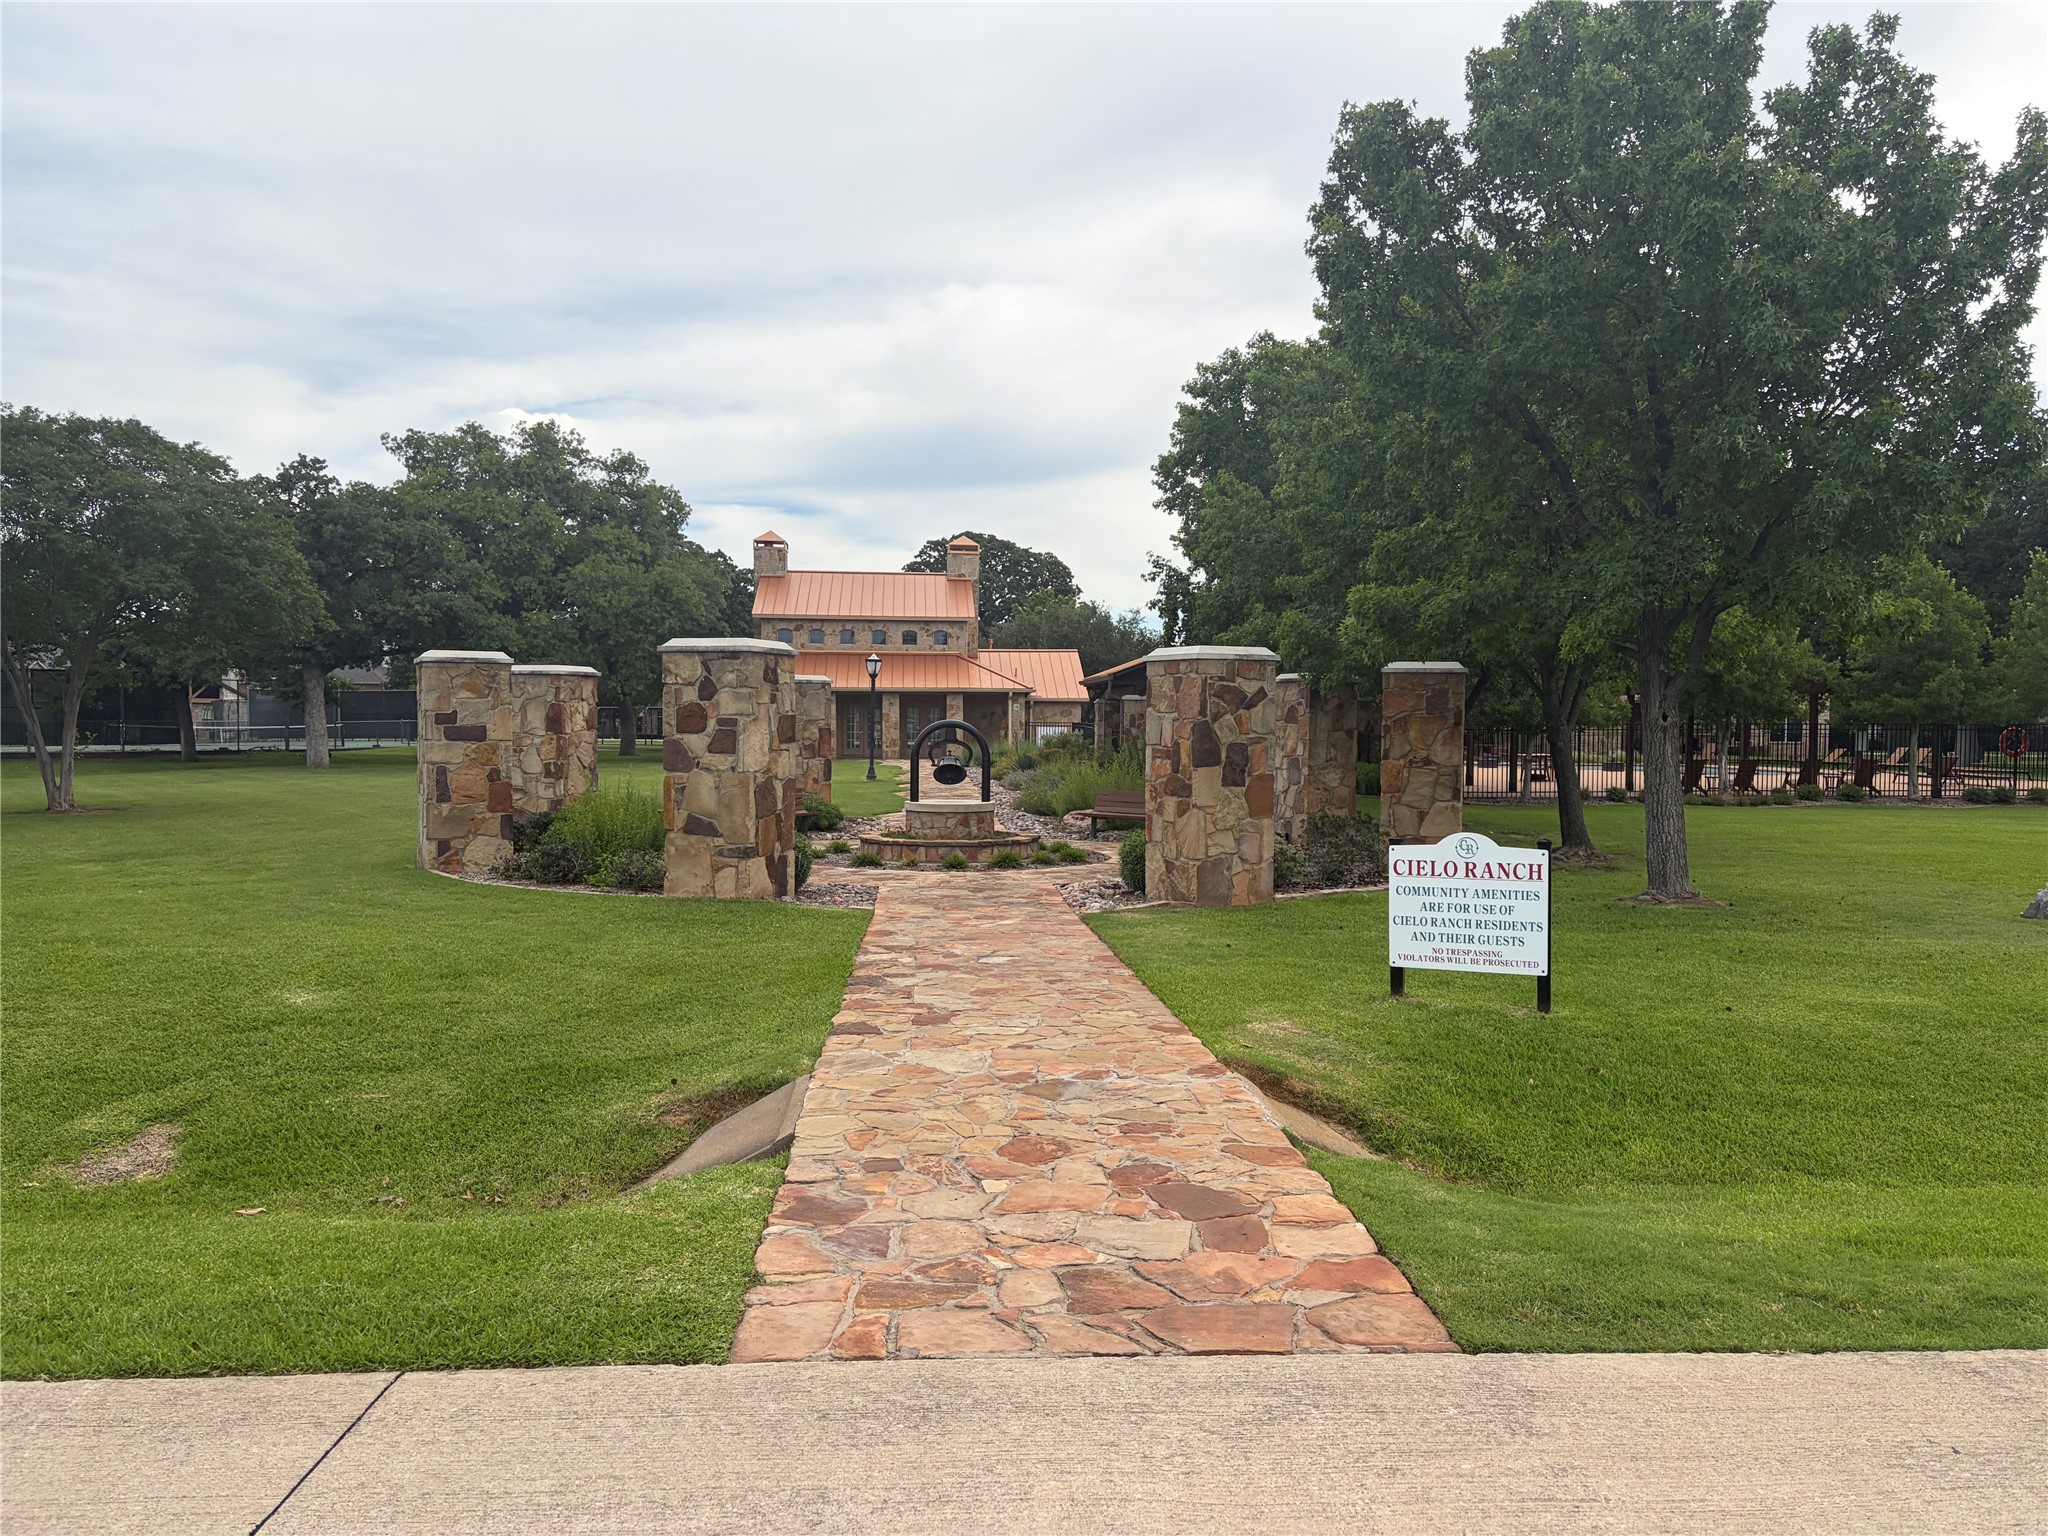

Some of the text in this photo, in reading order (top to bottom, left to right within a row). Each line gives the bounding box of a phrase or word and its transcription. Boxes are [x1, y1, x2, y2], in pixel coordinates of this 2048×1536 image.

[1393, 859, 1543, 880] CIELO RANCH
[1396, 885, 1540, 901] COMMUNITY AMENITIES
[1420, 902, 1515, 915] ARE FOR USE OF
[1393, 915, 1543, 932] CIELO RANCH RESIDENTS
[1411, 932, 1525, 947] AND THEIR GUESTS
[1398, 953, 1445, 963] VIOLATORS
[1482, 959, 1539, 969] PROSECUTED
[1446, 948, 1503, 958] TRESPASSING
